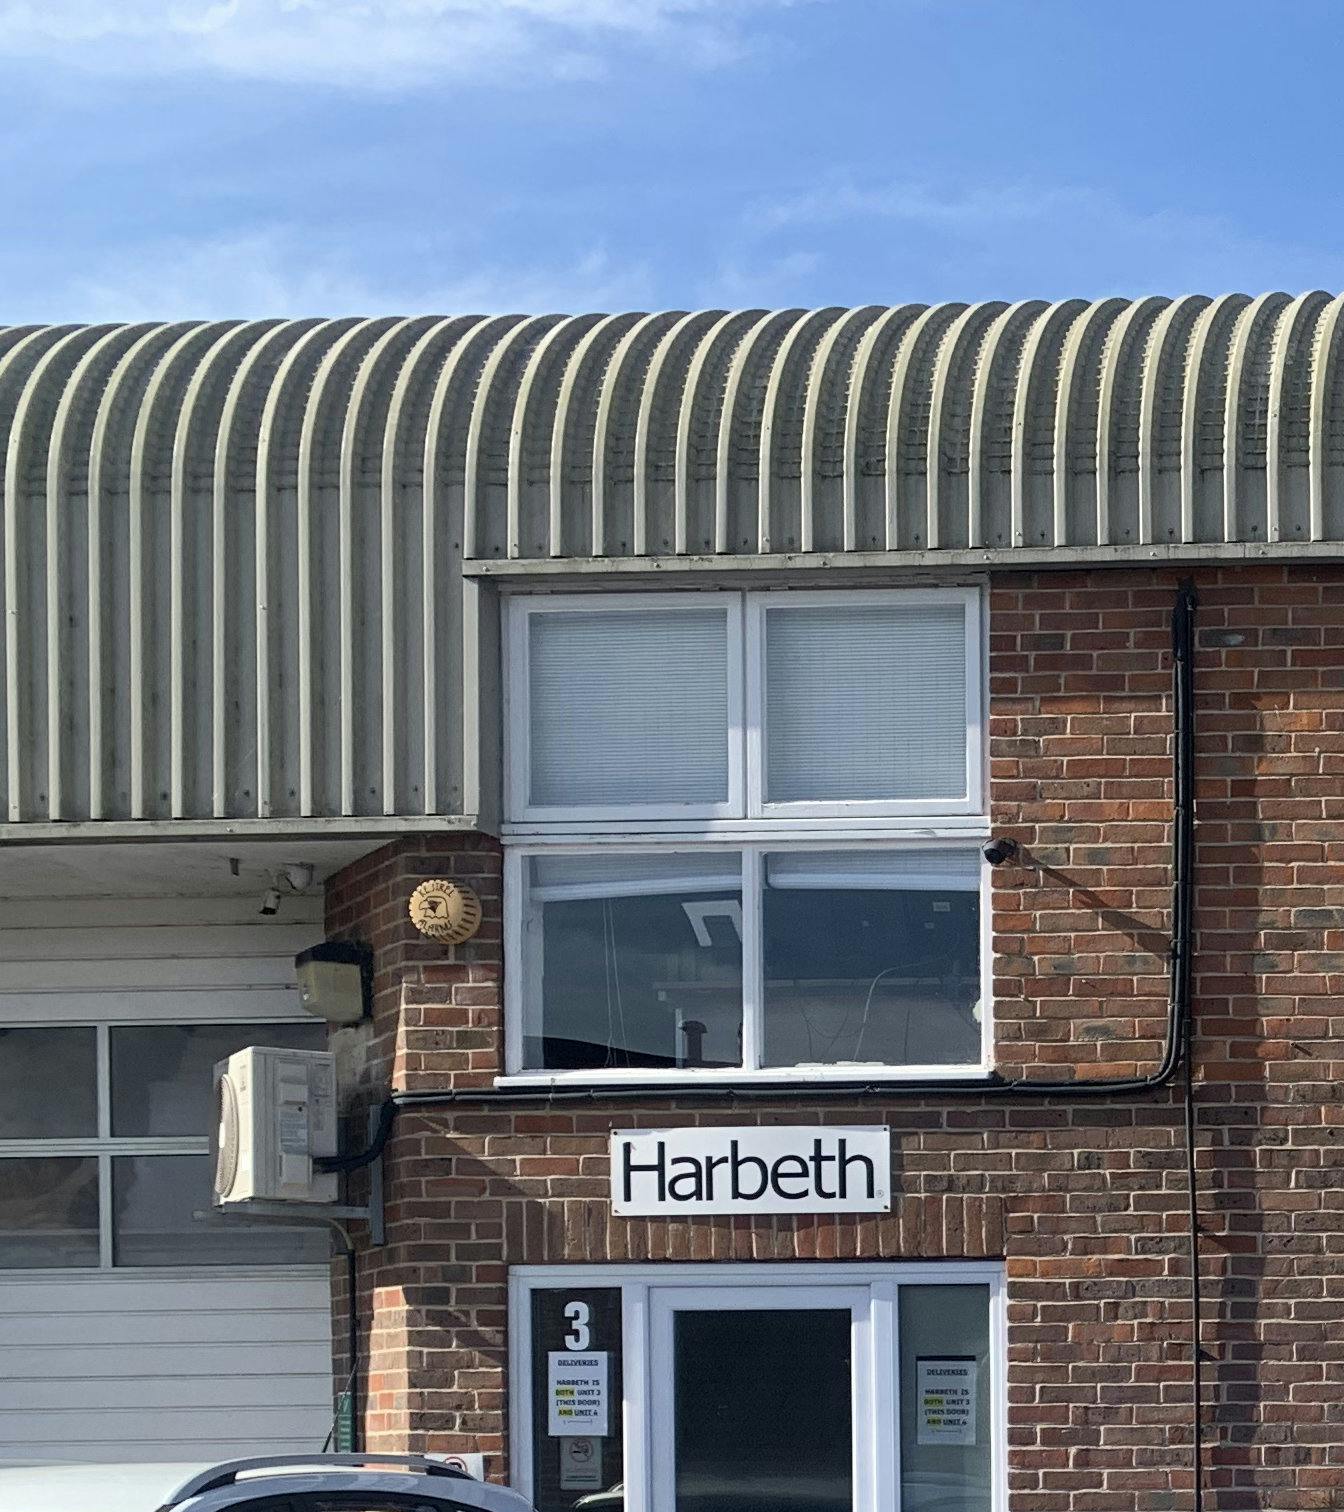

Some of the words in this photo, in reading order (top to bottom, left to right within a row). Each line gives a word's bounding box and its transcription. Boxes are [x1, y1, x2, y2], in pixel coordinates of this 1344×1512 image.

[622, 1138, 875, 1202] Harbeth
[564, 1301, 590, 1351] 3
[557, 1359, 598, 1367] DELIVERIES
[926, 1368, 968, 1376] DELIVERIES
